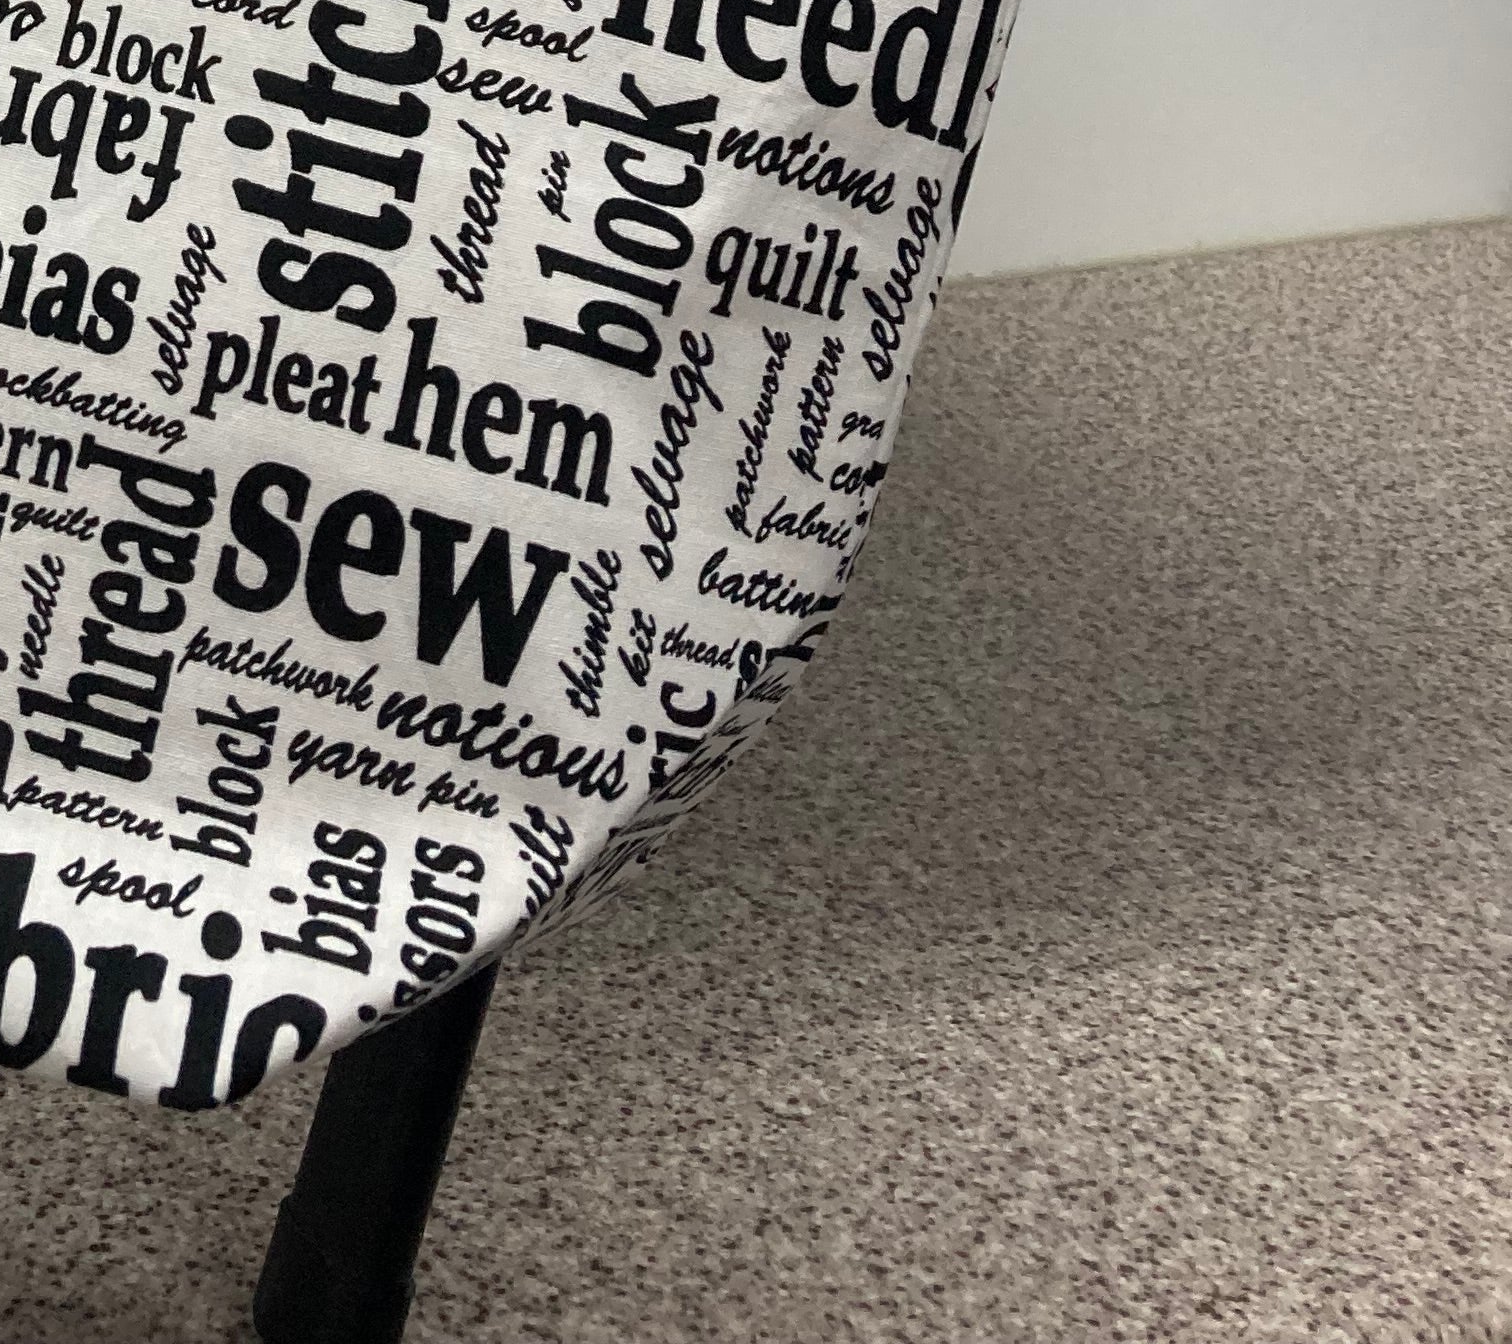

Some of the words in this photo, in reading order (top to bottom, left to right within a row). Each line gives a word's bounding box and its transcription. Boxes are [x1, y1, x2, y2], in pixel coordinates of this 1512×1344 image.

[430, 119, 510, 304] thread
[523, 72, 720, 378] block
[717, 126, 895, 215] notions
[147, 223, 229, 397] selvage
[705, 223, 859, 321] quilt
[862, 176, 942, 384] selvage
[190, 315, 382, 435] pleat
[383, 317, 612, 507] hem
[630, 330, 724, 581] selvage
[787, 336, 845, 483] pattern
[13, 433, 217, 783] thread
[19, 554, 65, 680] needle
[207, 462, 571, 693] sew
[177, 626, 379, 712] patchwork
[169, 695, 280, 867] block
[288, 730, 416, 796] yarn
[58, 857, 203, 918] spool
[261, 821, 386, 975] bias
